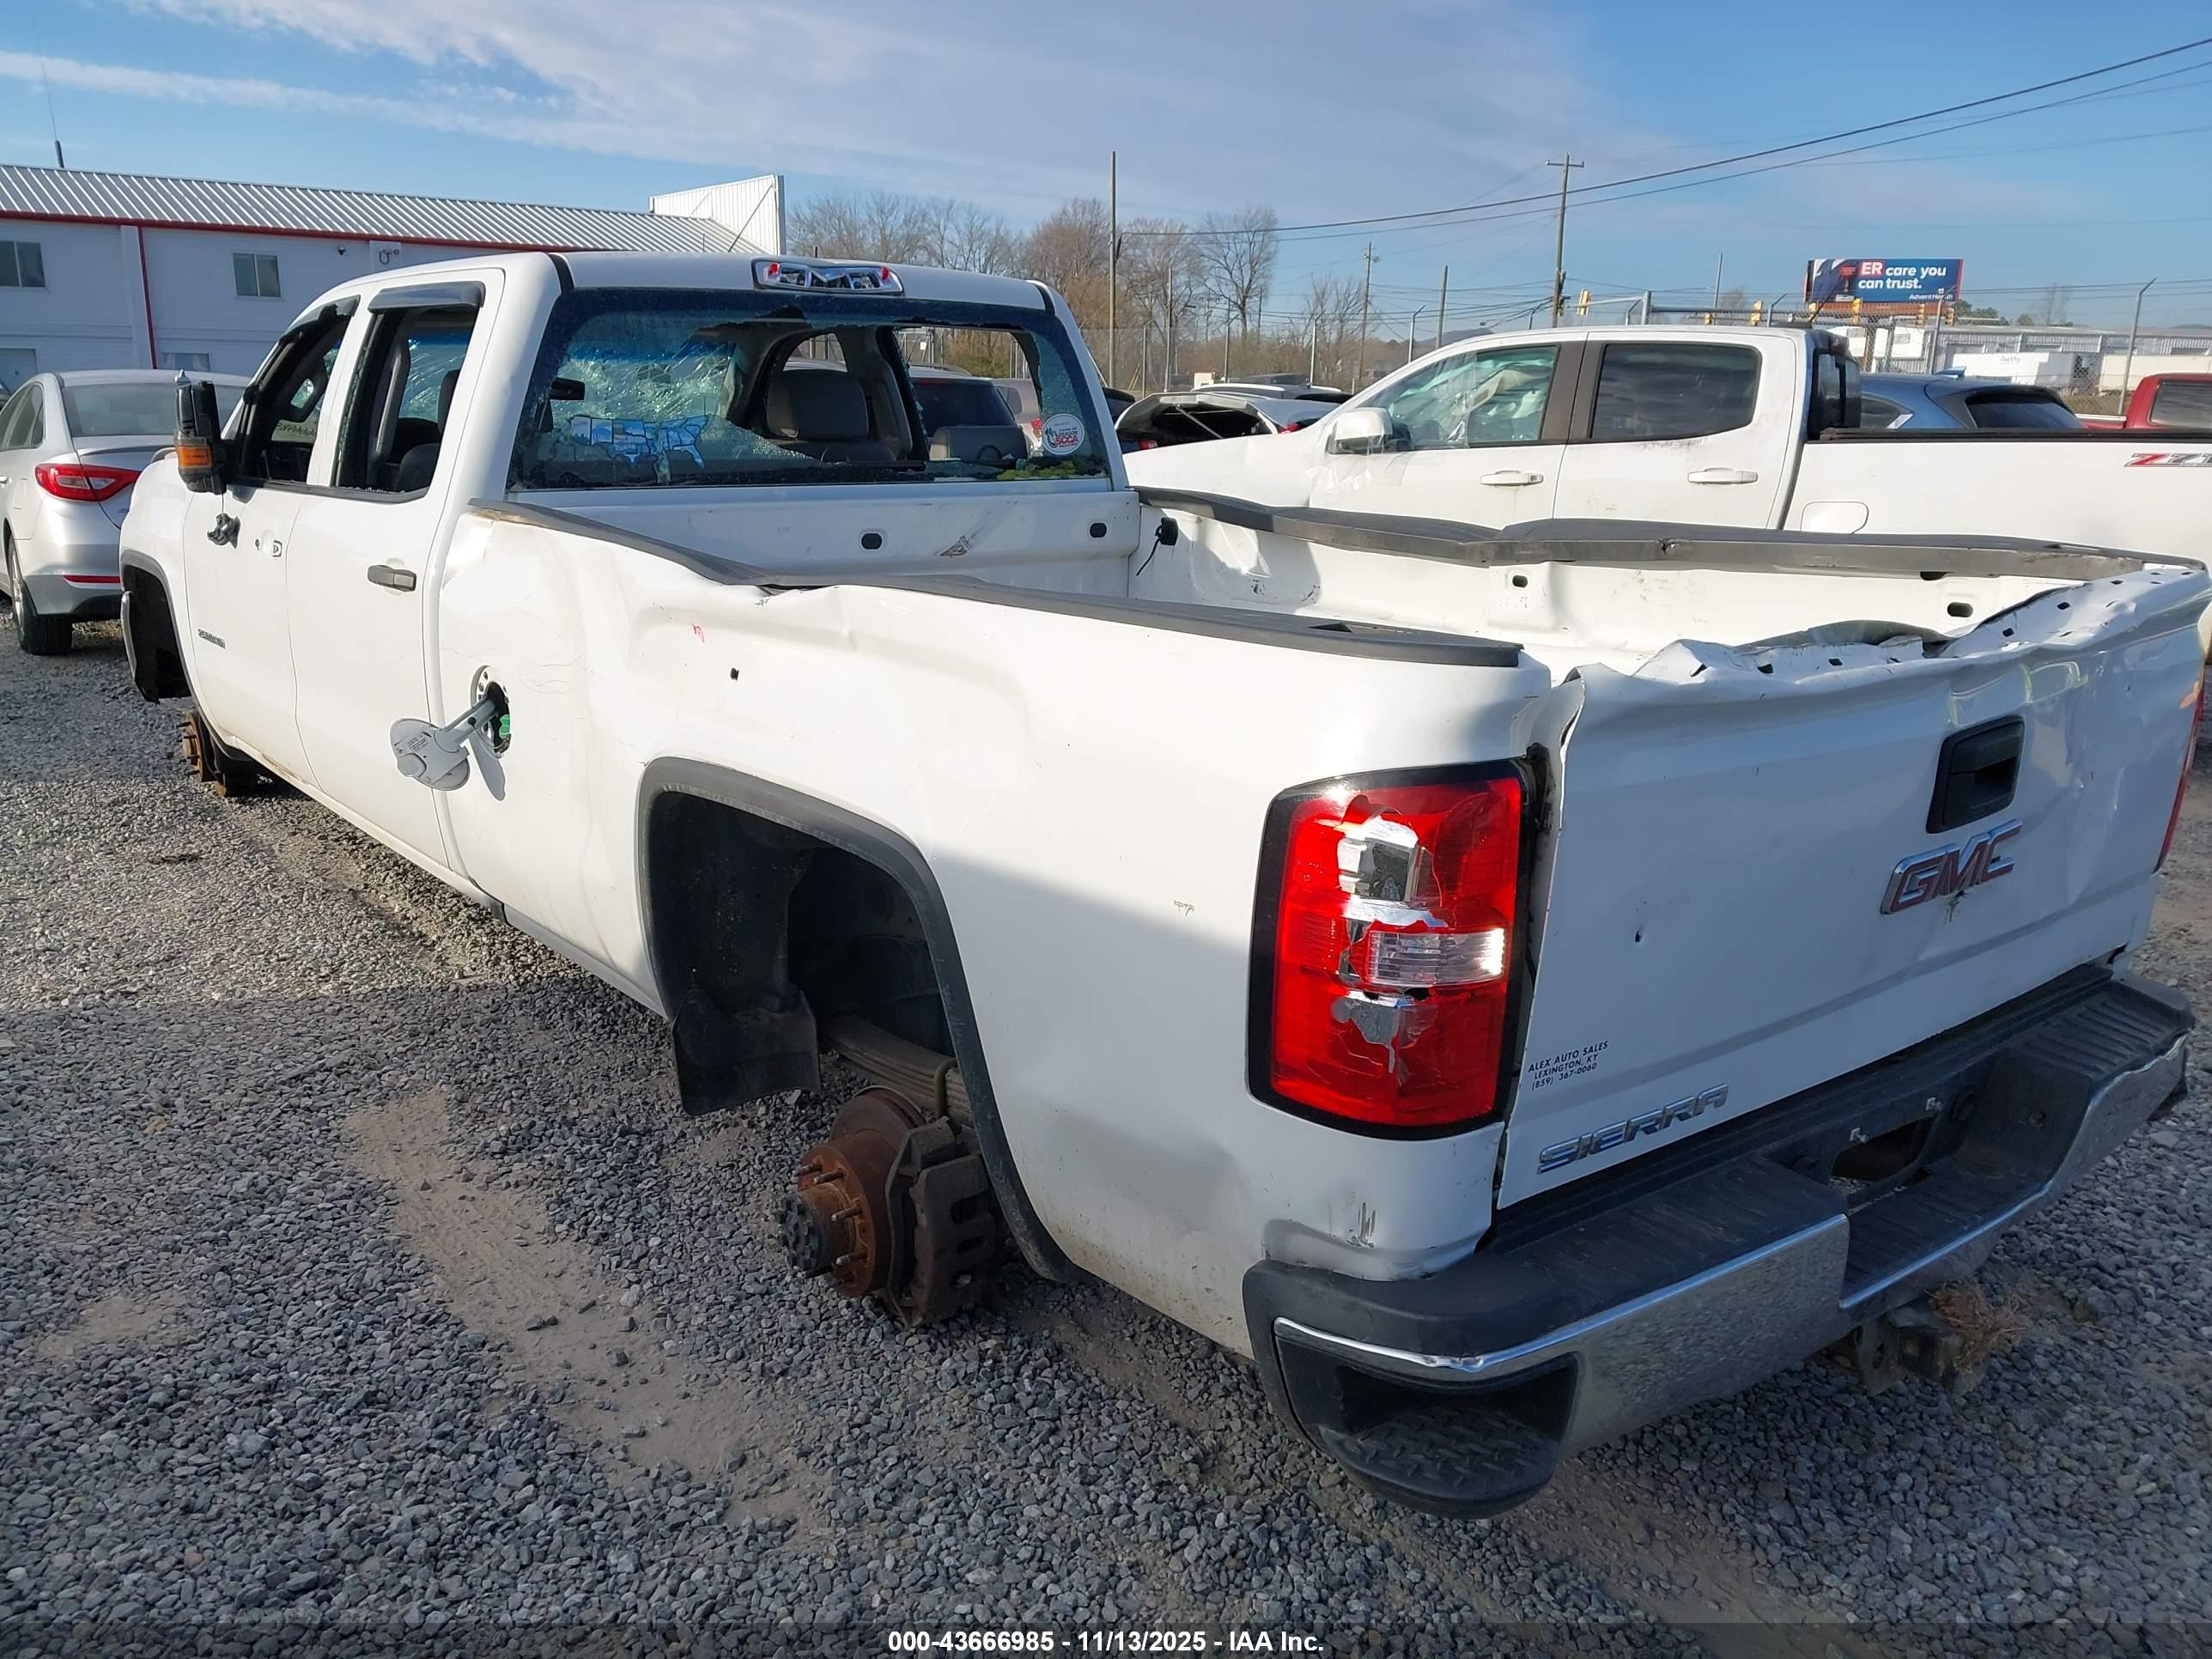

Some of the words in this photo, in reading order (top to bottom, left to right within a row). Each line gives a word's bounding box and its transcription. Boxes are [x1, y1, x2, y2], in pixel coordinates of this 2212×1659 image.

[1857, 279, 1884, 289] can
[1886, 277, 1923, 289] trust.
[1861, 261, 1883, 276] ER
[1885, 266, 1916, 276] care
[1920, 266, 1947, 279] you
[1880, 817, 2023, 915] GMC
[1528, 1057, 1552, 1073] ALEX
[1553, 1049, 1580, 1065] AUTO
[1582, 1040, 1608, 1056] SALES
[1534, 1058, 1583, 1080] LEXINGTON,
[1586, 1053, 1599, 1064] KY
[1532, 1076, 1554, 1091] (859)
[1559, 1062, 1597, 1081] 367-0060
[1536, 1082, 1729, 1175] SIERRA
